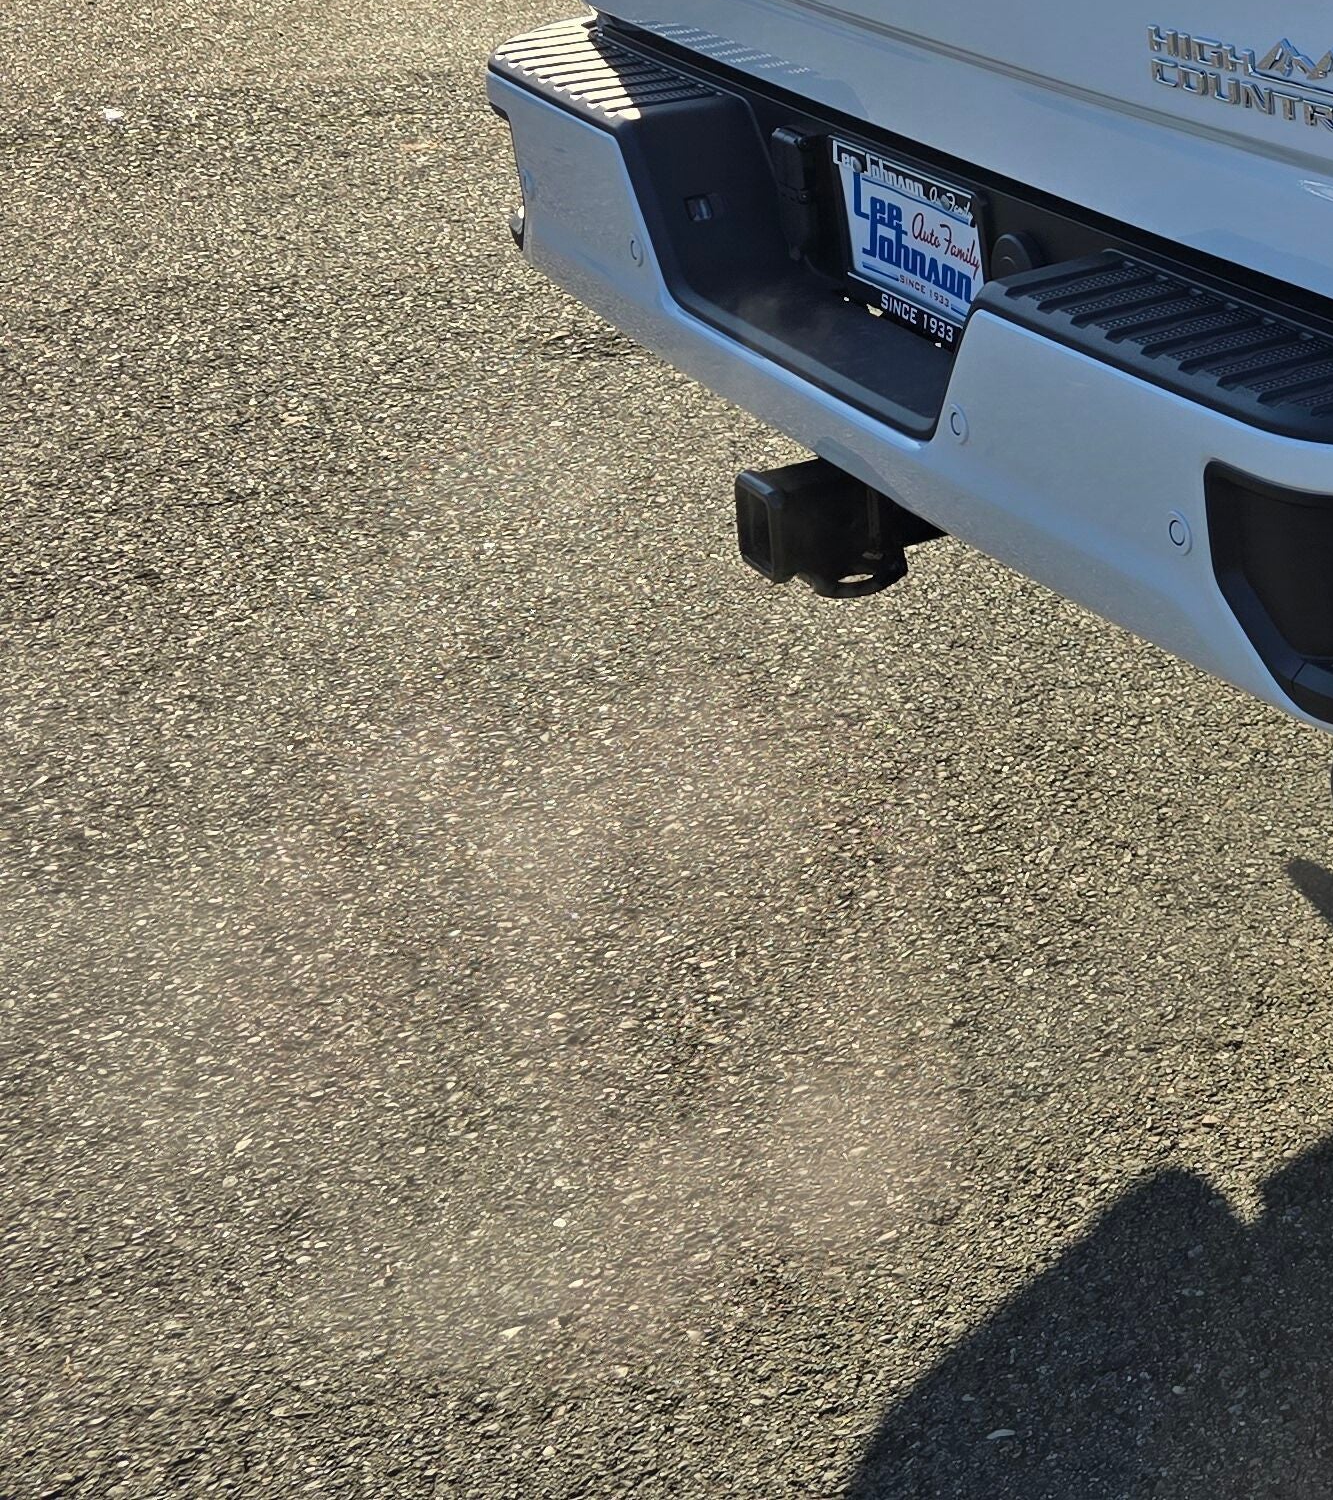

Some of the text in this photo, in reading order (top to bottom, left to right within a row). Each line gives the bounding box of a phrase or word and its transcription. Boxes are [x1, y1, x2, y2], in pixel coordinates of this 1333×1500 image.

[1147, 23, 1256, 76] HIGH
[854, 171, 906, 233] Lee
[863, 153, 928, 201] Johnson
[862, 222, 974, 304] Johnson
[911, 212, 981, 281] Auto Family
[880, 293, 954, 343] SINCE 1933
[898, 275, 951, 308] SINCE 1933
